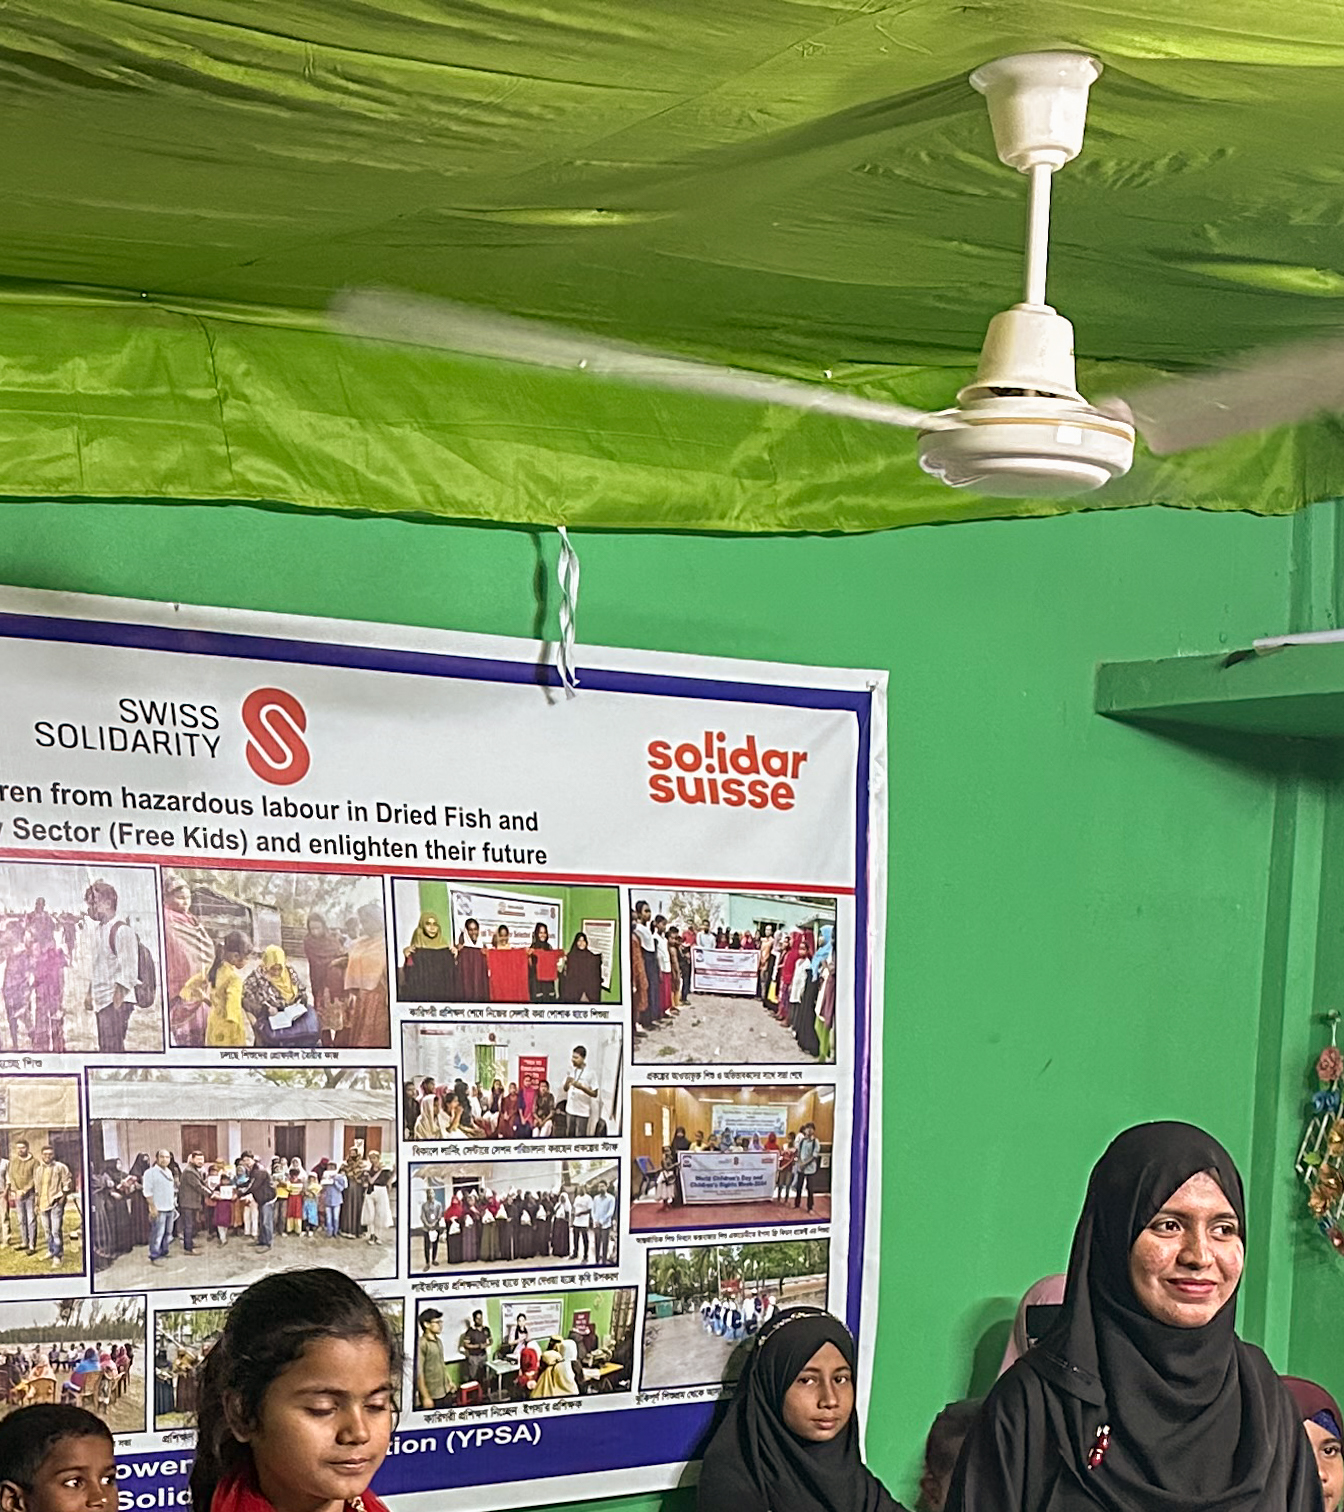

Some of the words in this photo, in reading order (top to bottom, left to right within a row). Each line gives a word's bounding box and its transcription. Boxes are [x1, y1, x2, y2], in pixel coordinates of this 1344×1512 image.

[119, 698, 219, 730] SWISS
[34, 721, 221, 758] SOLIDARITY
[50, 782, 113, 808] from
[121, 786, 254, 816] hazardous
[262, 795, 340, 821] labour
[348, 800, 368, 822] in
[376, 802, 437, 826] Dried
[445, 807, 491, 830] Fish
[498, 811, 538, 832] and
[649, 774, 795, 811] suisse
[12, 817, 101, 844] Sector
[109, 821, 175, 850] (Free
[183, 826, 249, 856] Kids)
[256, 832, 301, 853] and
[309, 835, 418, 861] enlighten
[425, 839, 476, 861] their
[482, 842, 548, 865] future
[115, 1458, 194, 1480] ower
[384, 1434, 437, 1456] tion
[446, 1422, 542, 1454] (YPSA)
